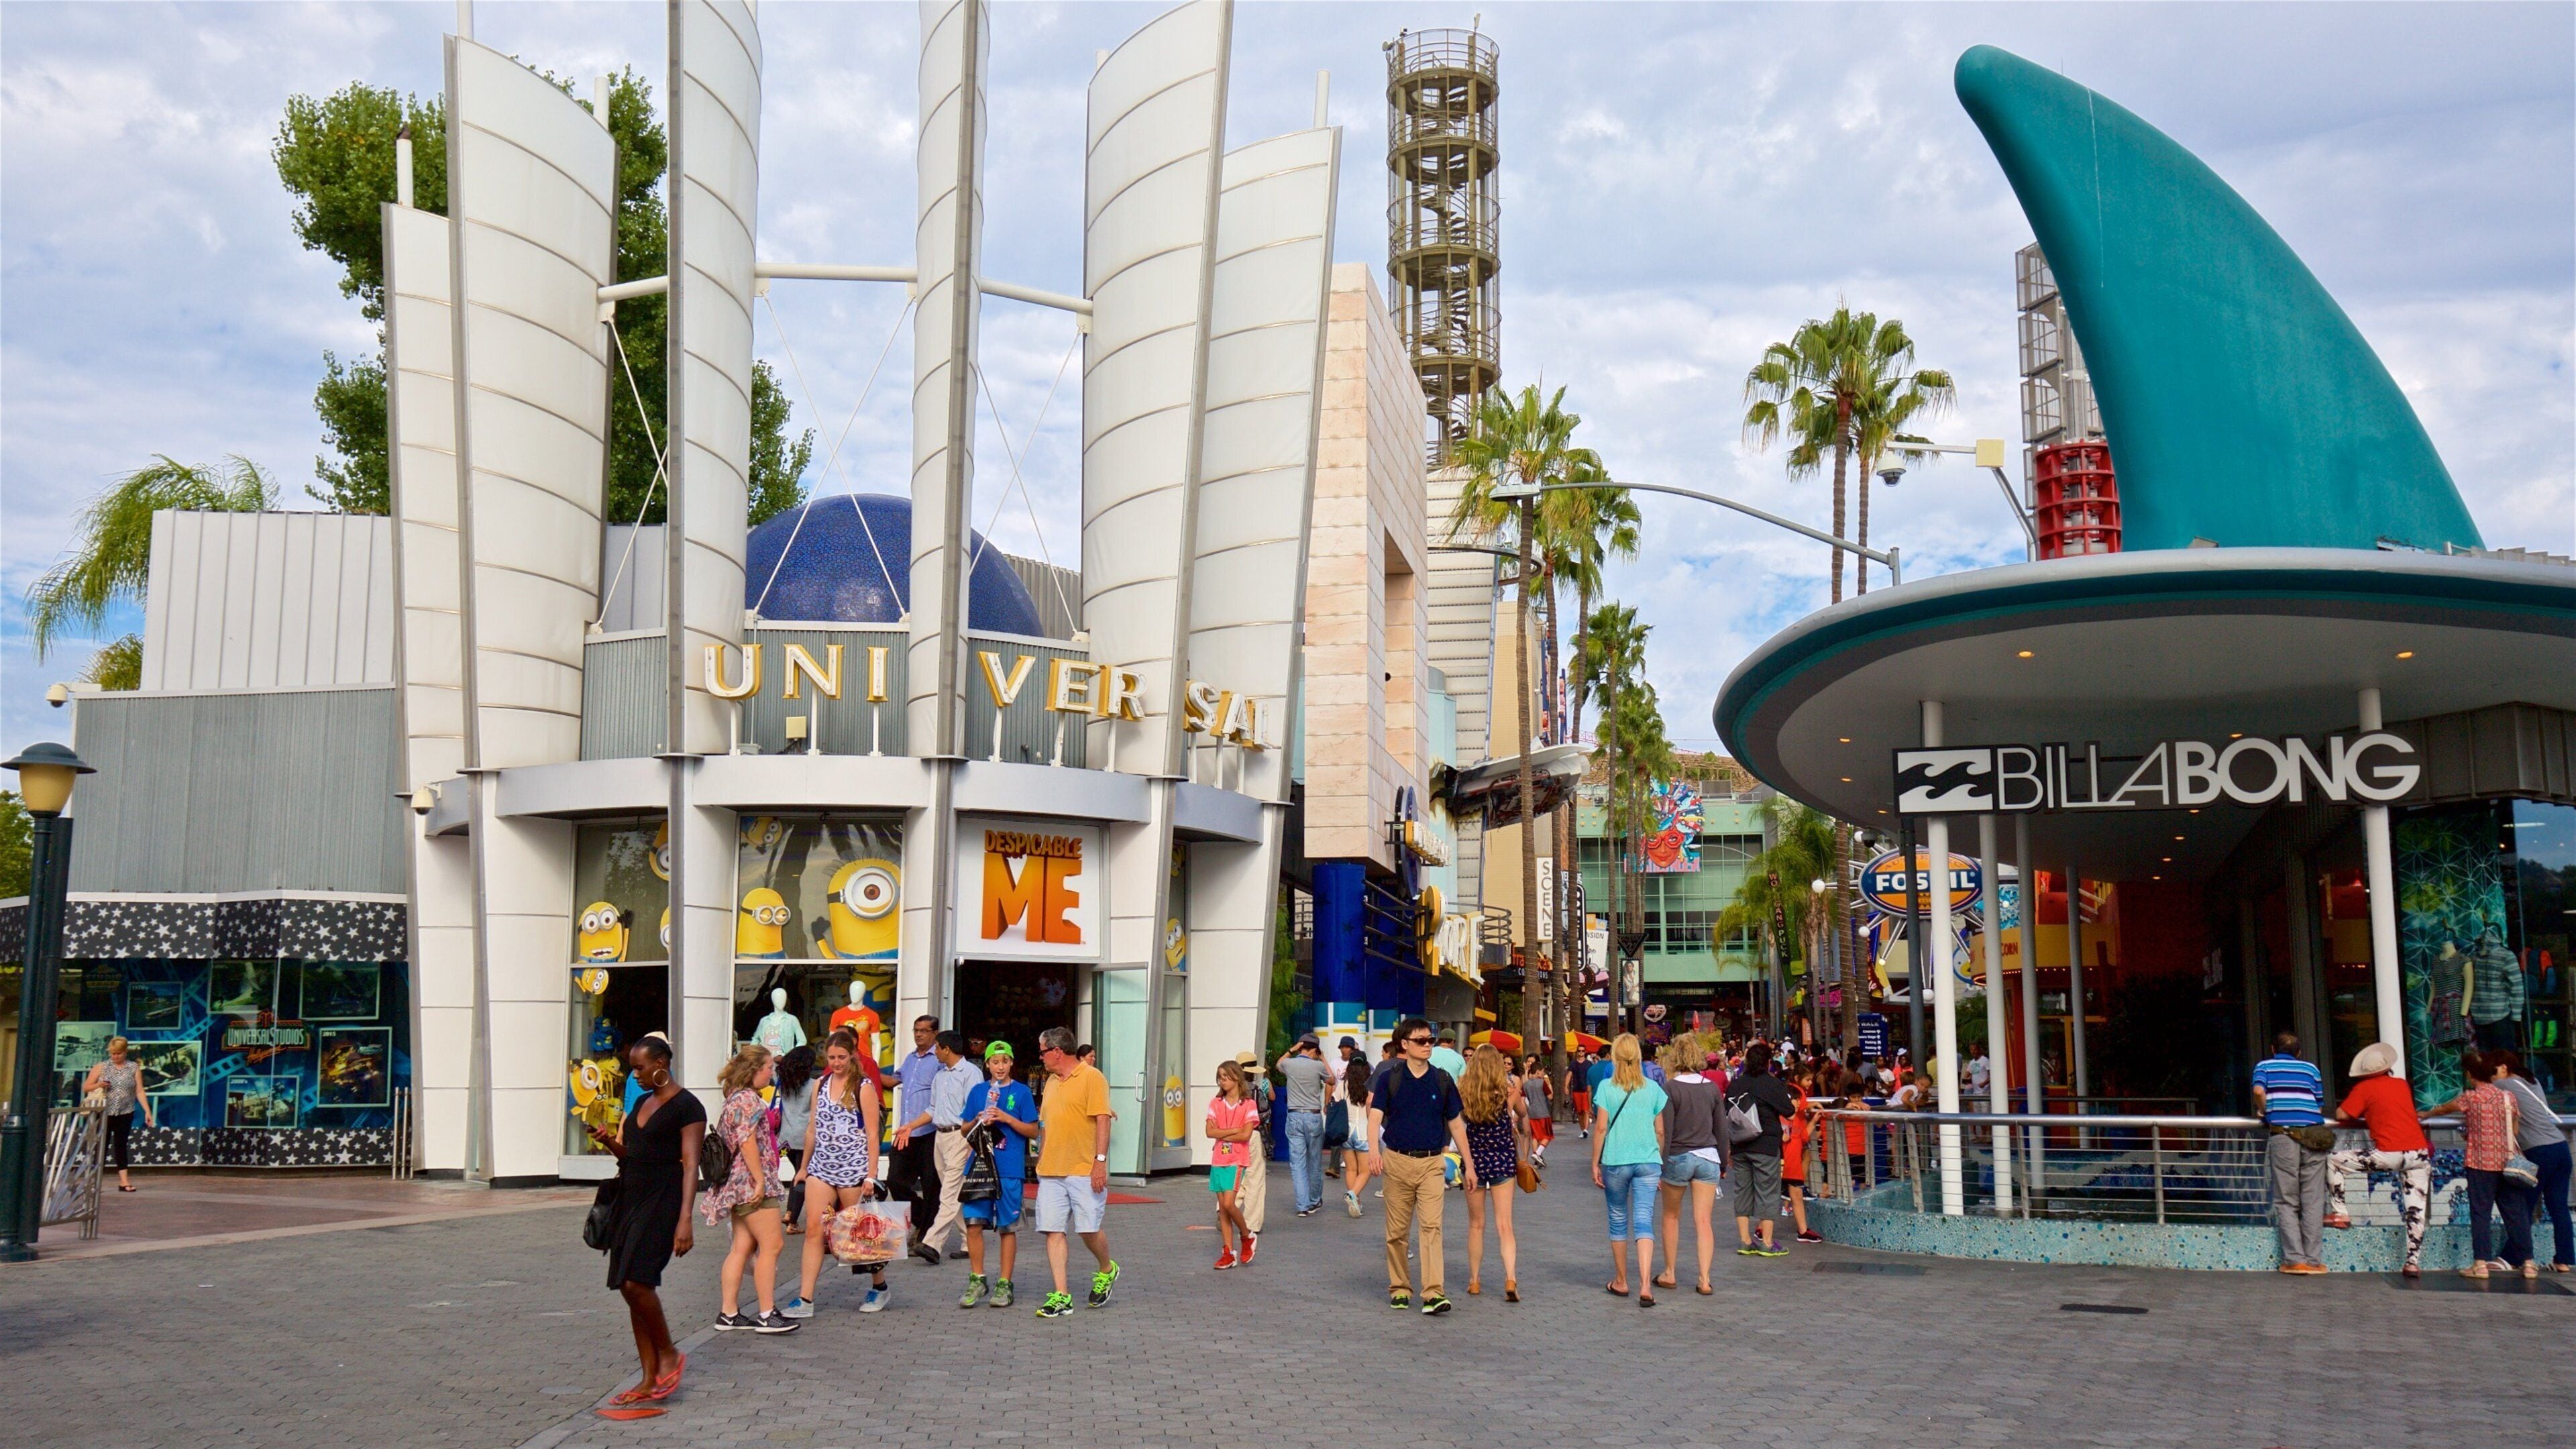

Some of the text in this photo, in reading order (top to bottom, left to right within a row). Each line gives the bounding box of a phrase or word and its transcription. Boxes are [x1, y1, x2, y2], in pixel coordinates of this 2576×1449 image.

[1997, 733, 2420, 810] BILLABONG
[985, 829, 1083, 859] DESPICABLE
[981, 851, 1083, 945] ME
[1541, 861, 1552, 937] SCENE
[1768, 873, 1785, 928] WOGANG
[1876, 871, 1975, 892] FOSIL
[1778, 929, 1789, 958] PUCK
